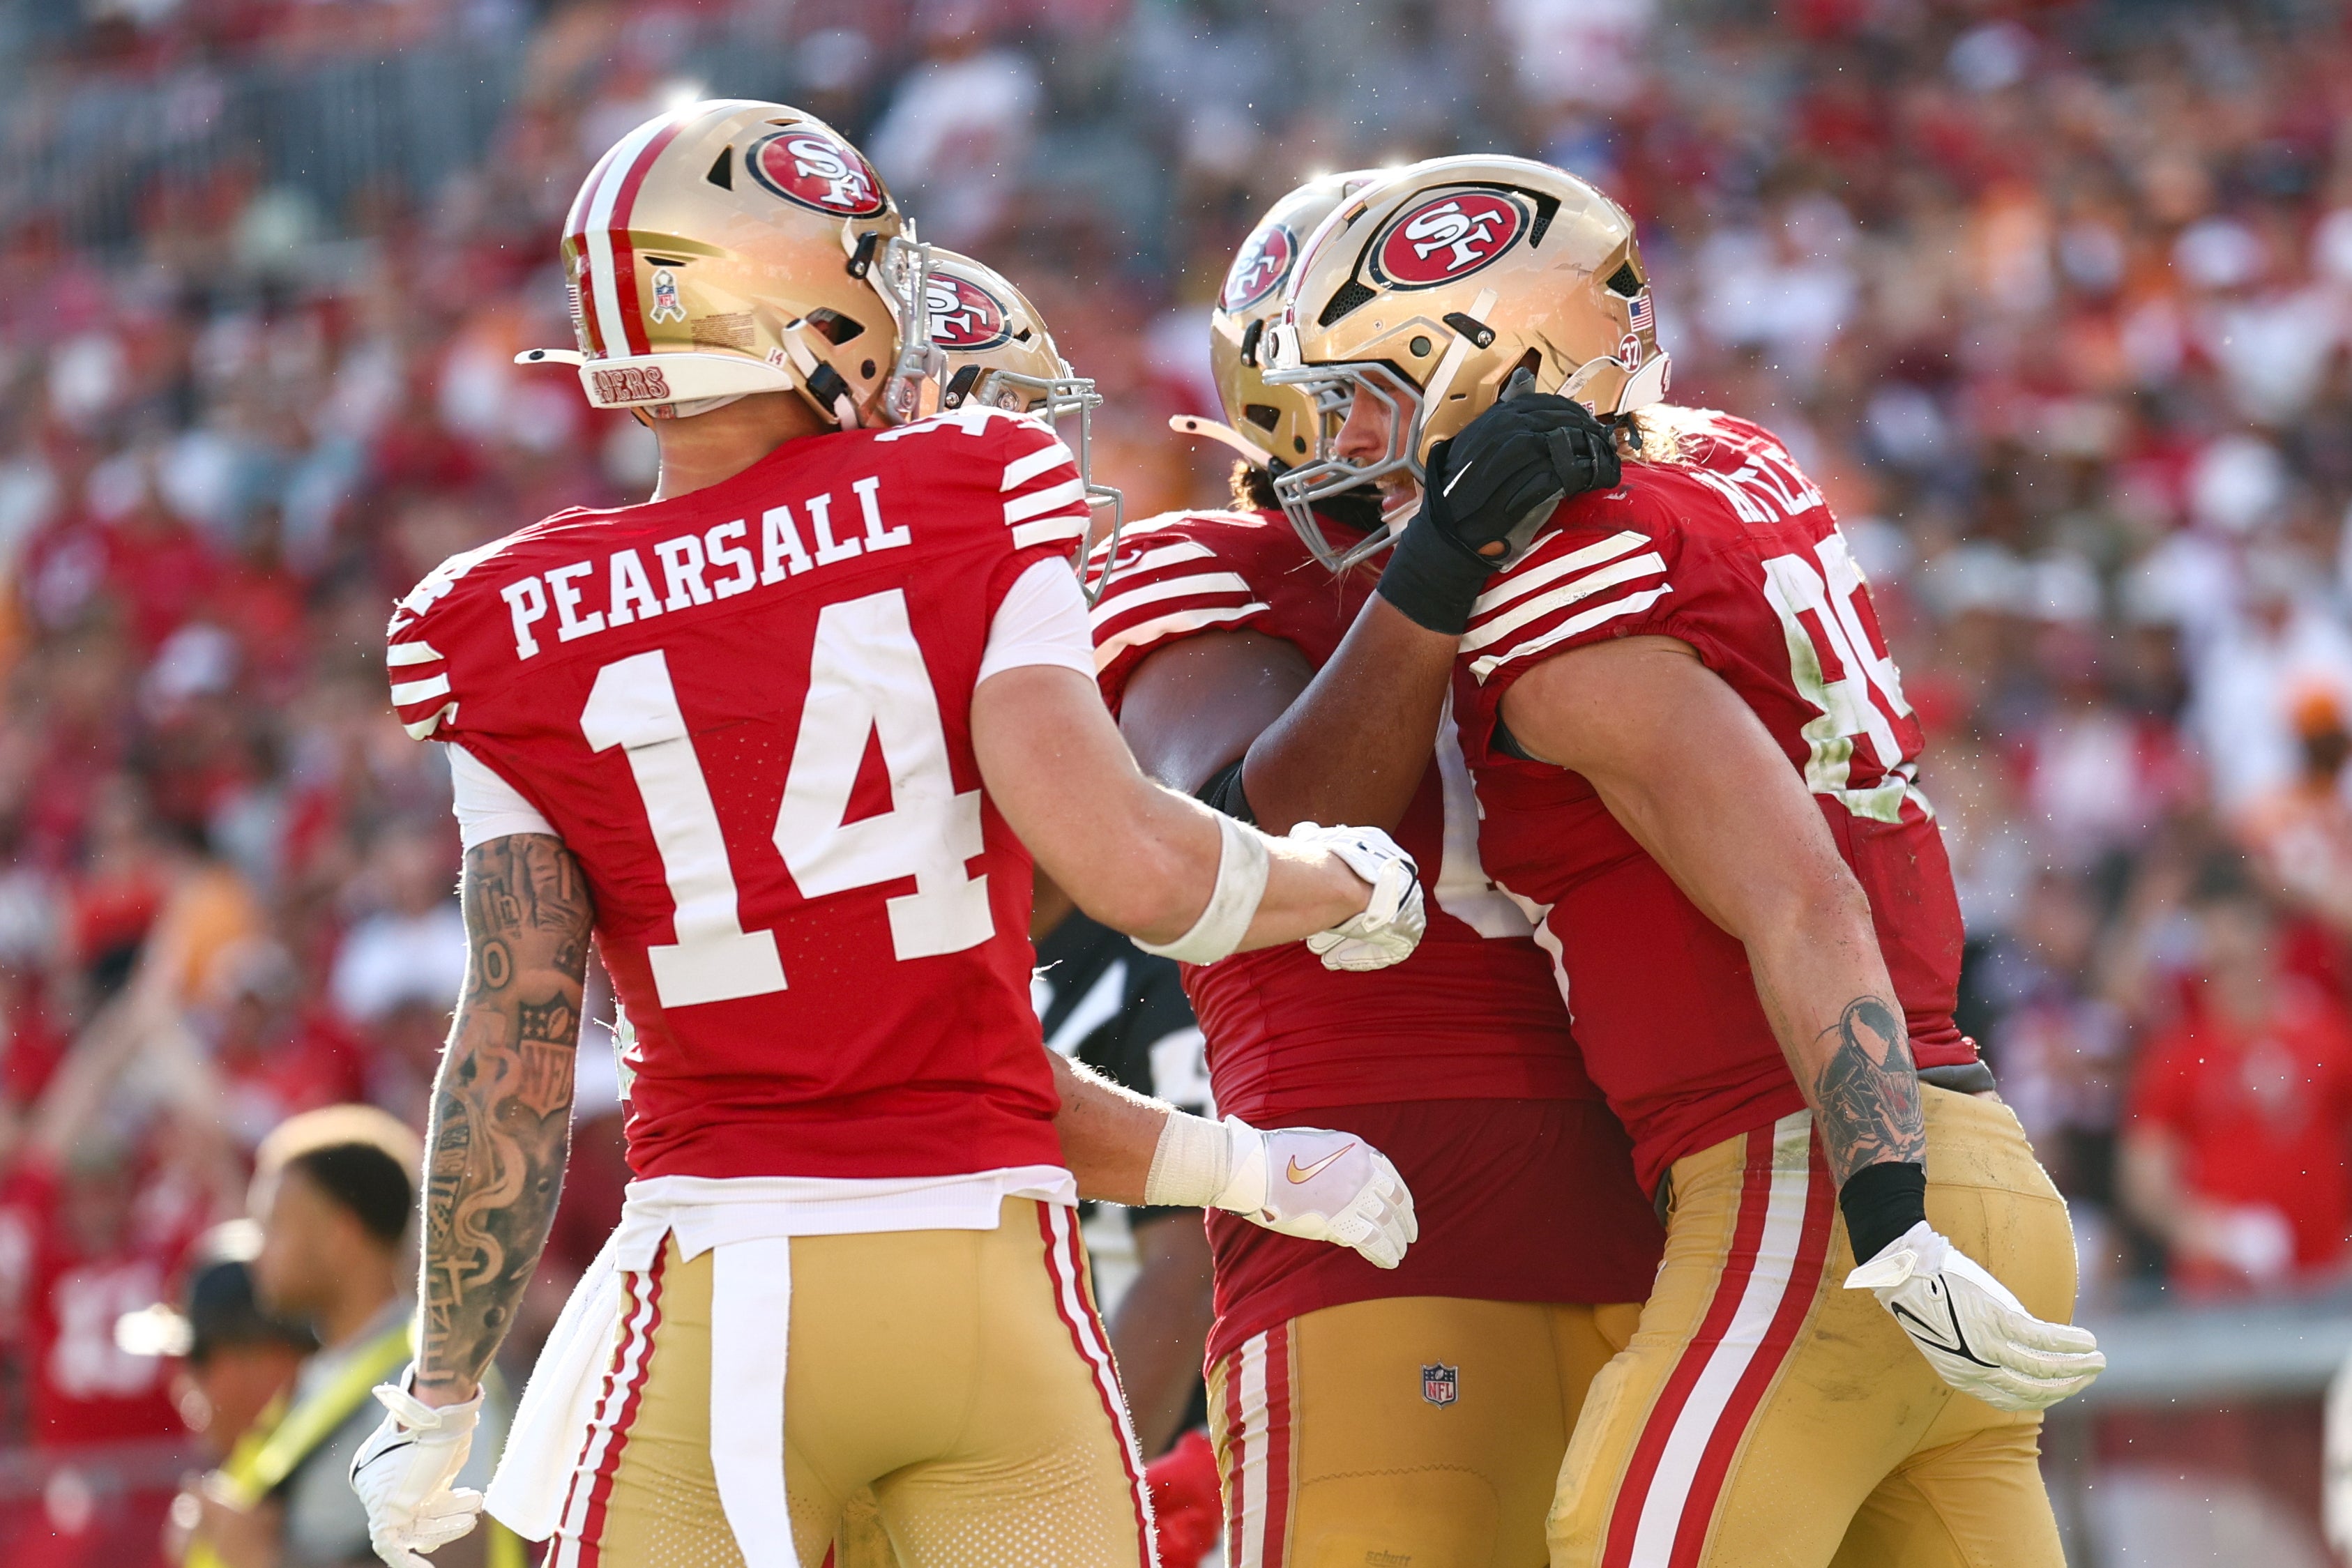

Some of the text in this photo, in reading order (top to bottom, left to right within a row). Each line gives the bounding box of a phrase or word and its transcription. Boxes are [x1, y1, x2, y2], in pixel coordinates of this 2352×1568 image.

[1405, 201, 1503, 271] SF
[768, 349, 784, 366] 14
[1621, 341, 1639, 370] 37
[500, 476, 911, 660] PEARSALL
[579, 588, 995, 1008] 14
[1427, 1382, 1453, 1400] NFL
